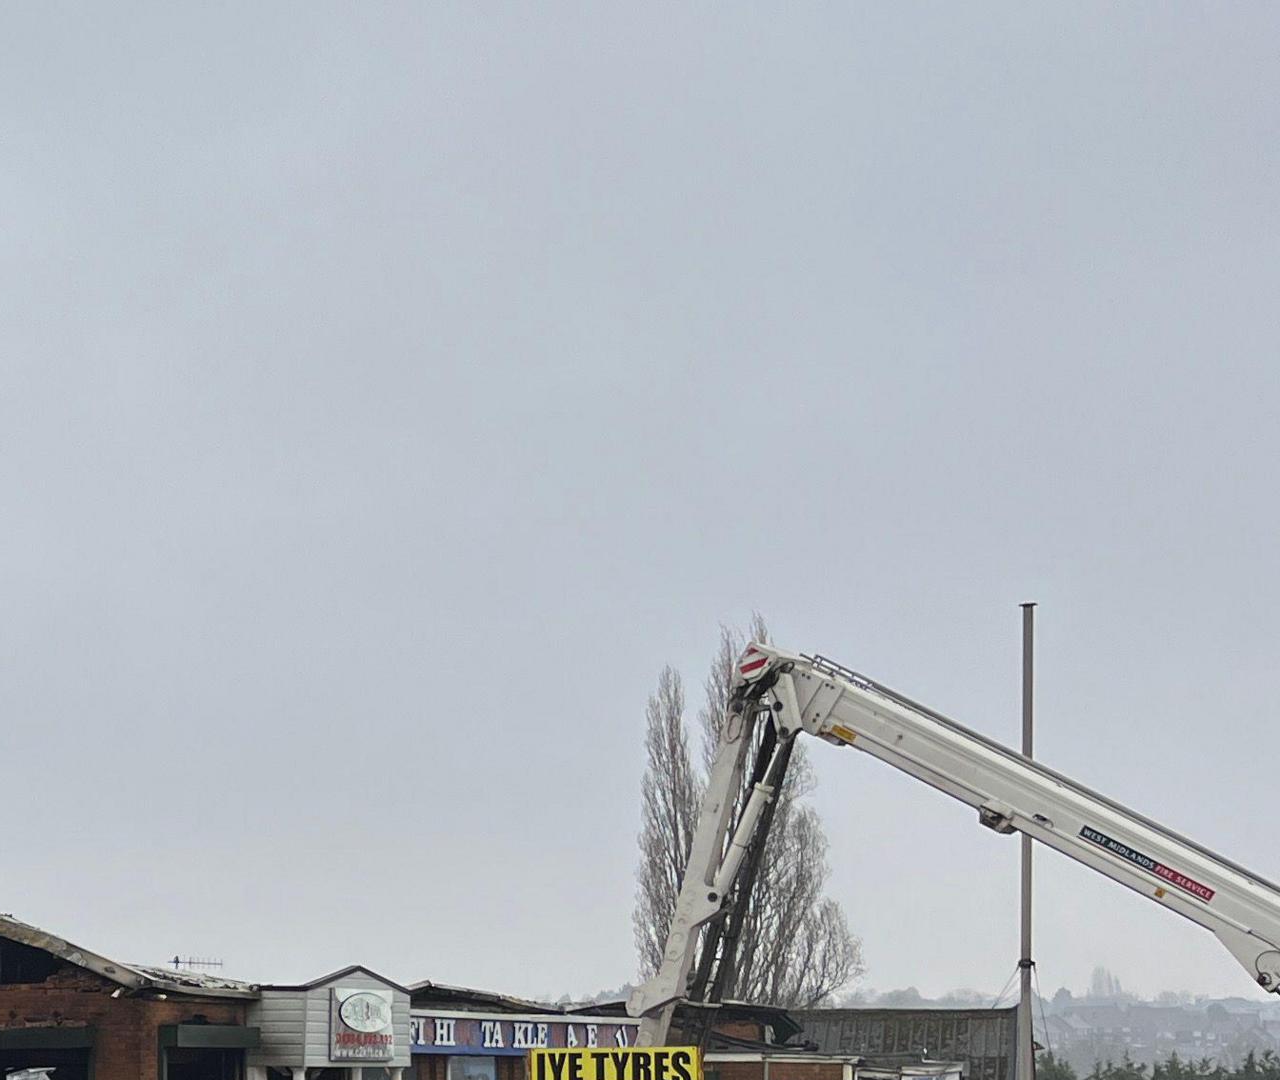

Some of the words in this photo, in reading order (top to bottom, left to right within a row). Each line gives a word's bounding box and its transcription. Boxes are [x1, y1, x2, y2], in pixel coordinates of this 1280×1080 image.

[1083, 826, 1106, 845] WEST
[1109, 838, 1155, 870] MIDLANDS
[1154, 864, 1175, 880] FIRE
[1175, 874, 1212, 899] SERVICE
